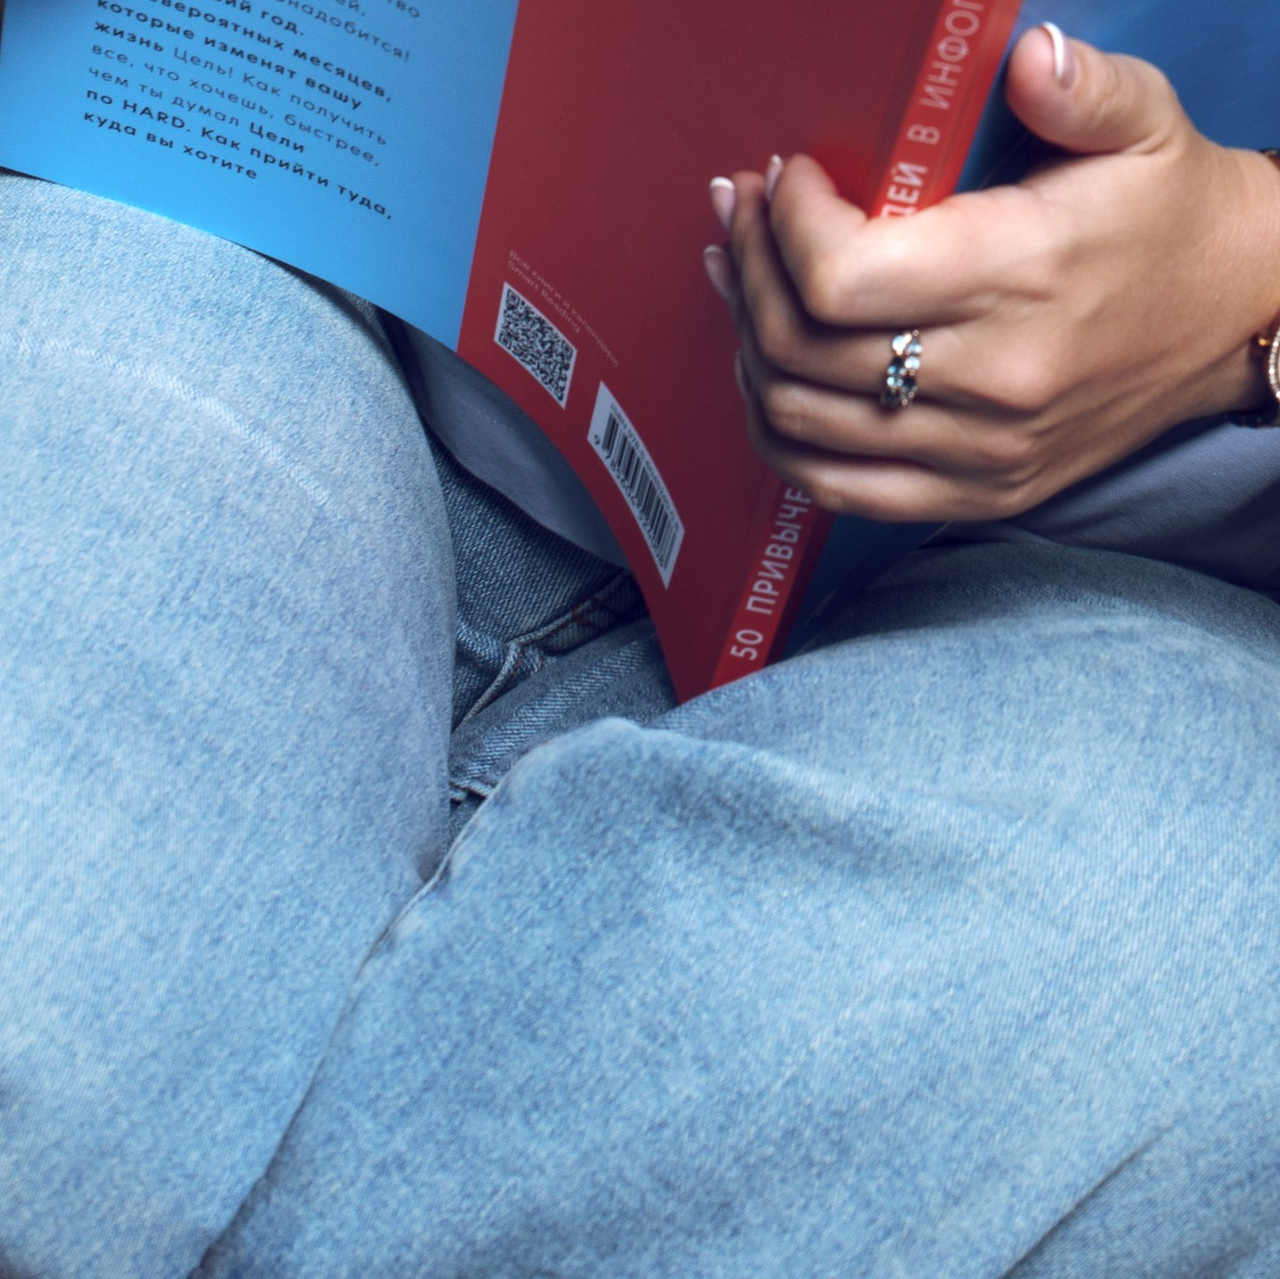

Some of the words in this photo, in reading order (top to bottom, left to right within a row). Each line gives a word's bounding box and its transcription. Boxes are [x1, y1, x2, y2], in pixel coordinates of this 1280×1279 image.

[260, 9, 304, 36] год.
[93, 20, 164, 52] жизнь
[173, 46, 233, 78] Цель!
[242, 72, 281, 97] Как
[289, 93, 386, 145] получить
[143, 61, 180, 82] что
[203, 35, 296, 79] изменят
[304, 76, 362, 110] вашу
[292, 47, 391, 102] месяцев,
[88, 66, 128, 87] чем
[138, 83, 163, 99] ты
[170, 95, 239, 127] думал
[248, 121, 305, 154] Цели
[906, 123, 941, 145] В
[83, 111, 136, 136] куда
[145, 131, 174, 149] вы
[182, 144, 257, 179] хотите
[85, 89, 113, 105] по
[122, 98, 190, 132] HARD.
[200, 126, 240, 151] Как
[249, 147, 329, 187] прийти
[337, 184, 391, 220] туда,
[879, 160, 928, 220] ДЕЙ
[746, 487, 812, 615] ПРИВЫЧЕ
[730, 628, 764, 661] 50
